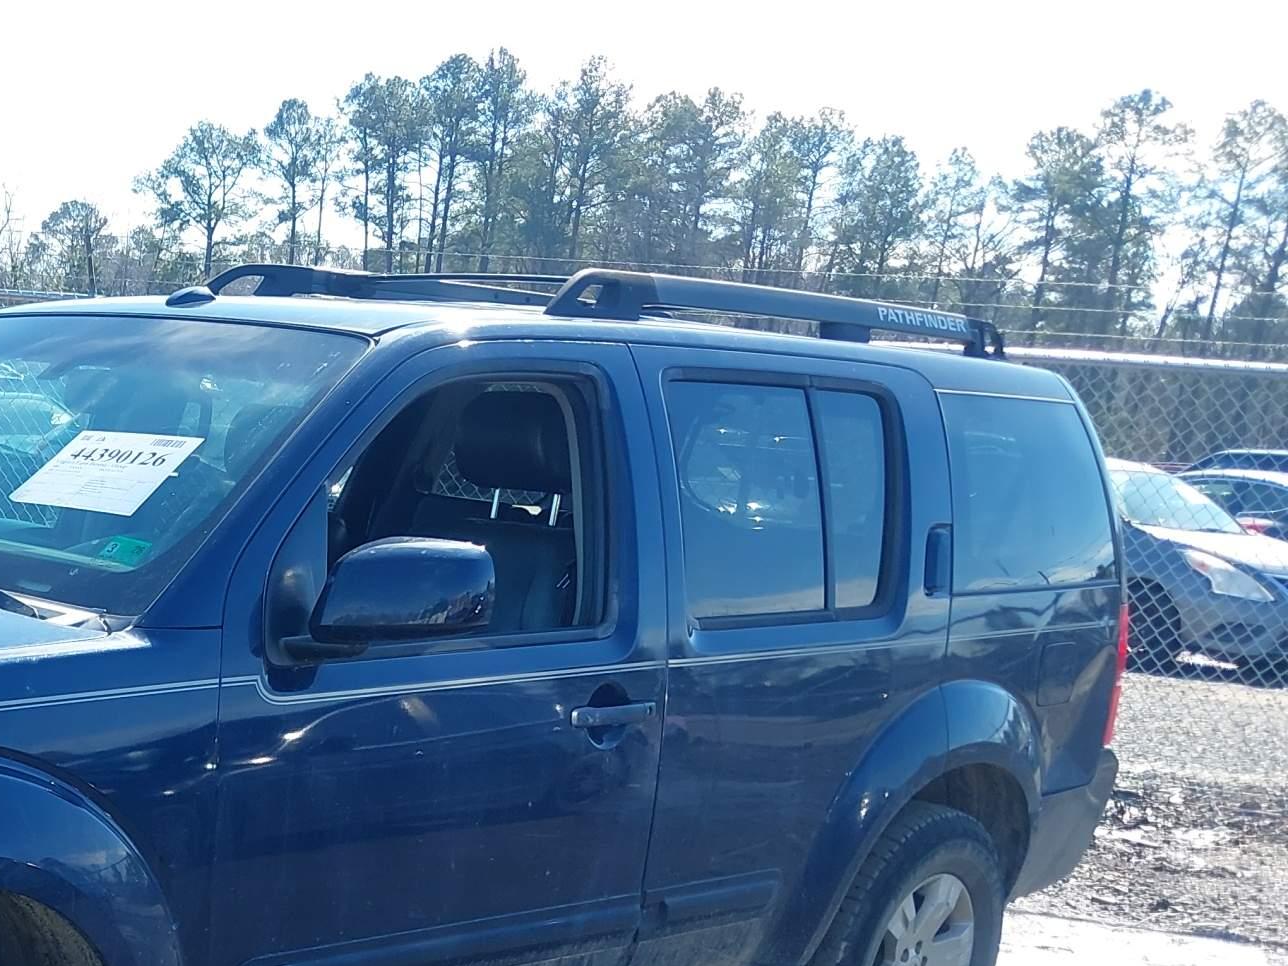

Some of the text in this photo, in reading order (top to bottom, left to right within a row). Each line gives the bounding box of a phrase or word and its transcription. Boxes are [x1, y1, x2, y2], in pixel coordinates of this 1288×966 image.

[877, 307, 967, 332] PATHFINDER
[70, 447, 172, 467] 44390126
[106, 543, 118, 553] 3
